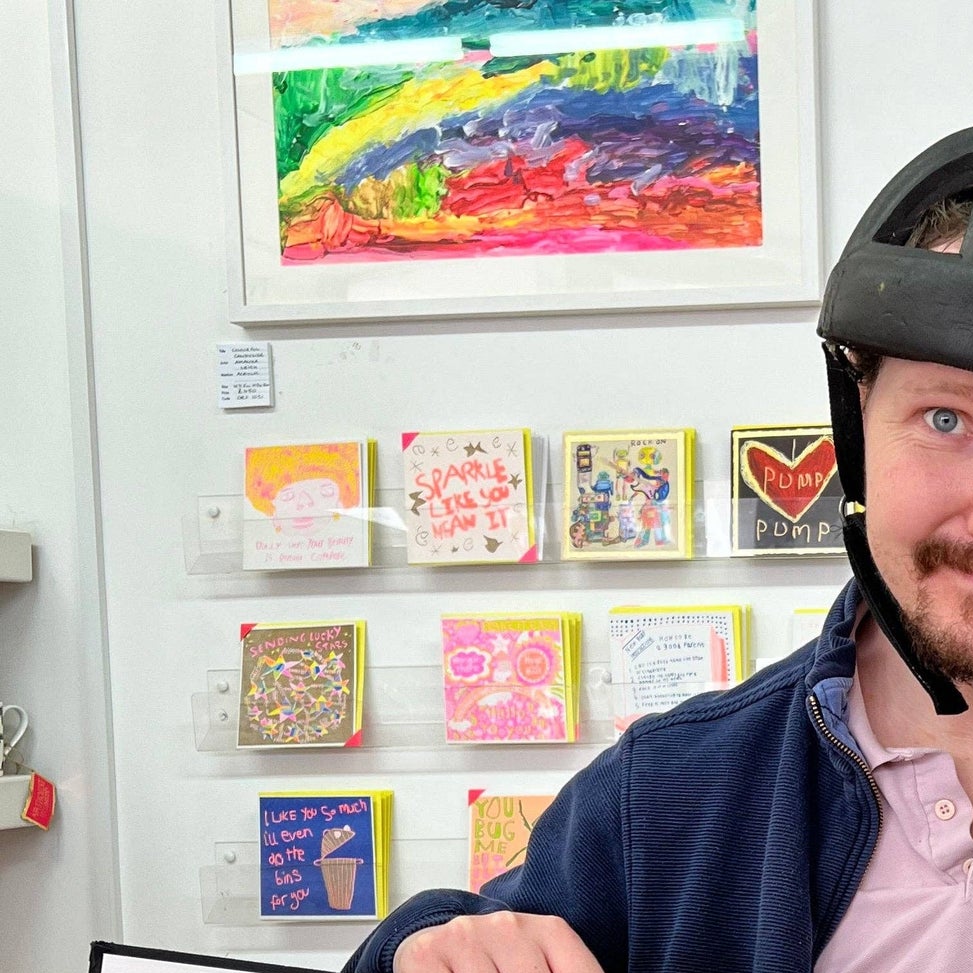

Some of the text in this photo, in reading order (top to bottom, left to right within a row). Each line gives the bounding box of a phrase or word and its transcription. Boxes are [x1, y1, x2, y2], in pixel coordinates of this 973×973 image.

[630, 438, 667, 448] ROCK ON
[415, 458, 508, 501] SPARKLE
[430, 486, 510, 519] LIKE YOU
[431, 506, 510, 540] MEAN IT
[249, 626, 342, 658] SENDING LUCKY
[315, 640, 349, 652] STARS
[271, 810, 298, 824] LIKE
[473, 796, 515, 819] YOU
[280, 828, 314, 844] even
[474, 817, 516, 842] BUG
[268, 845, 306, 867] do the
[474, 839, 509, 854] ME
[273, 868, 303, 886] bins
[269, 887, 311, 911] for you
